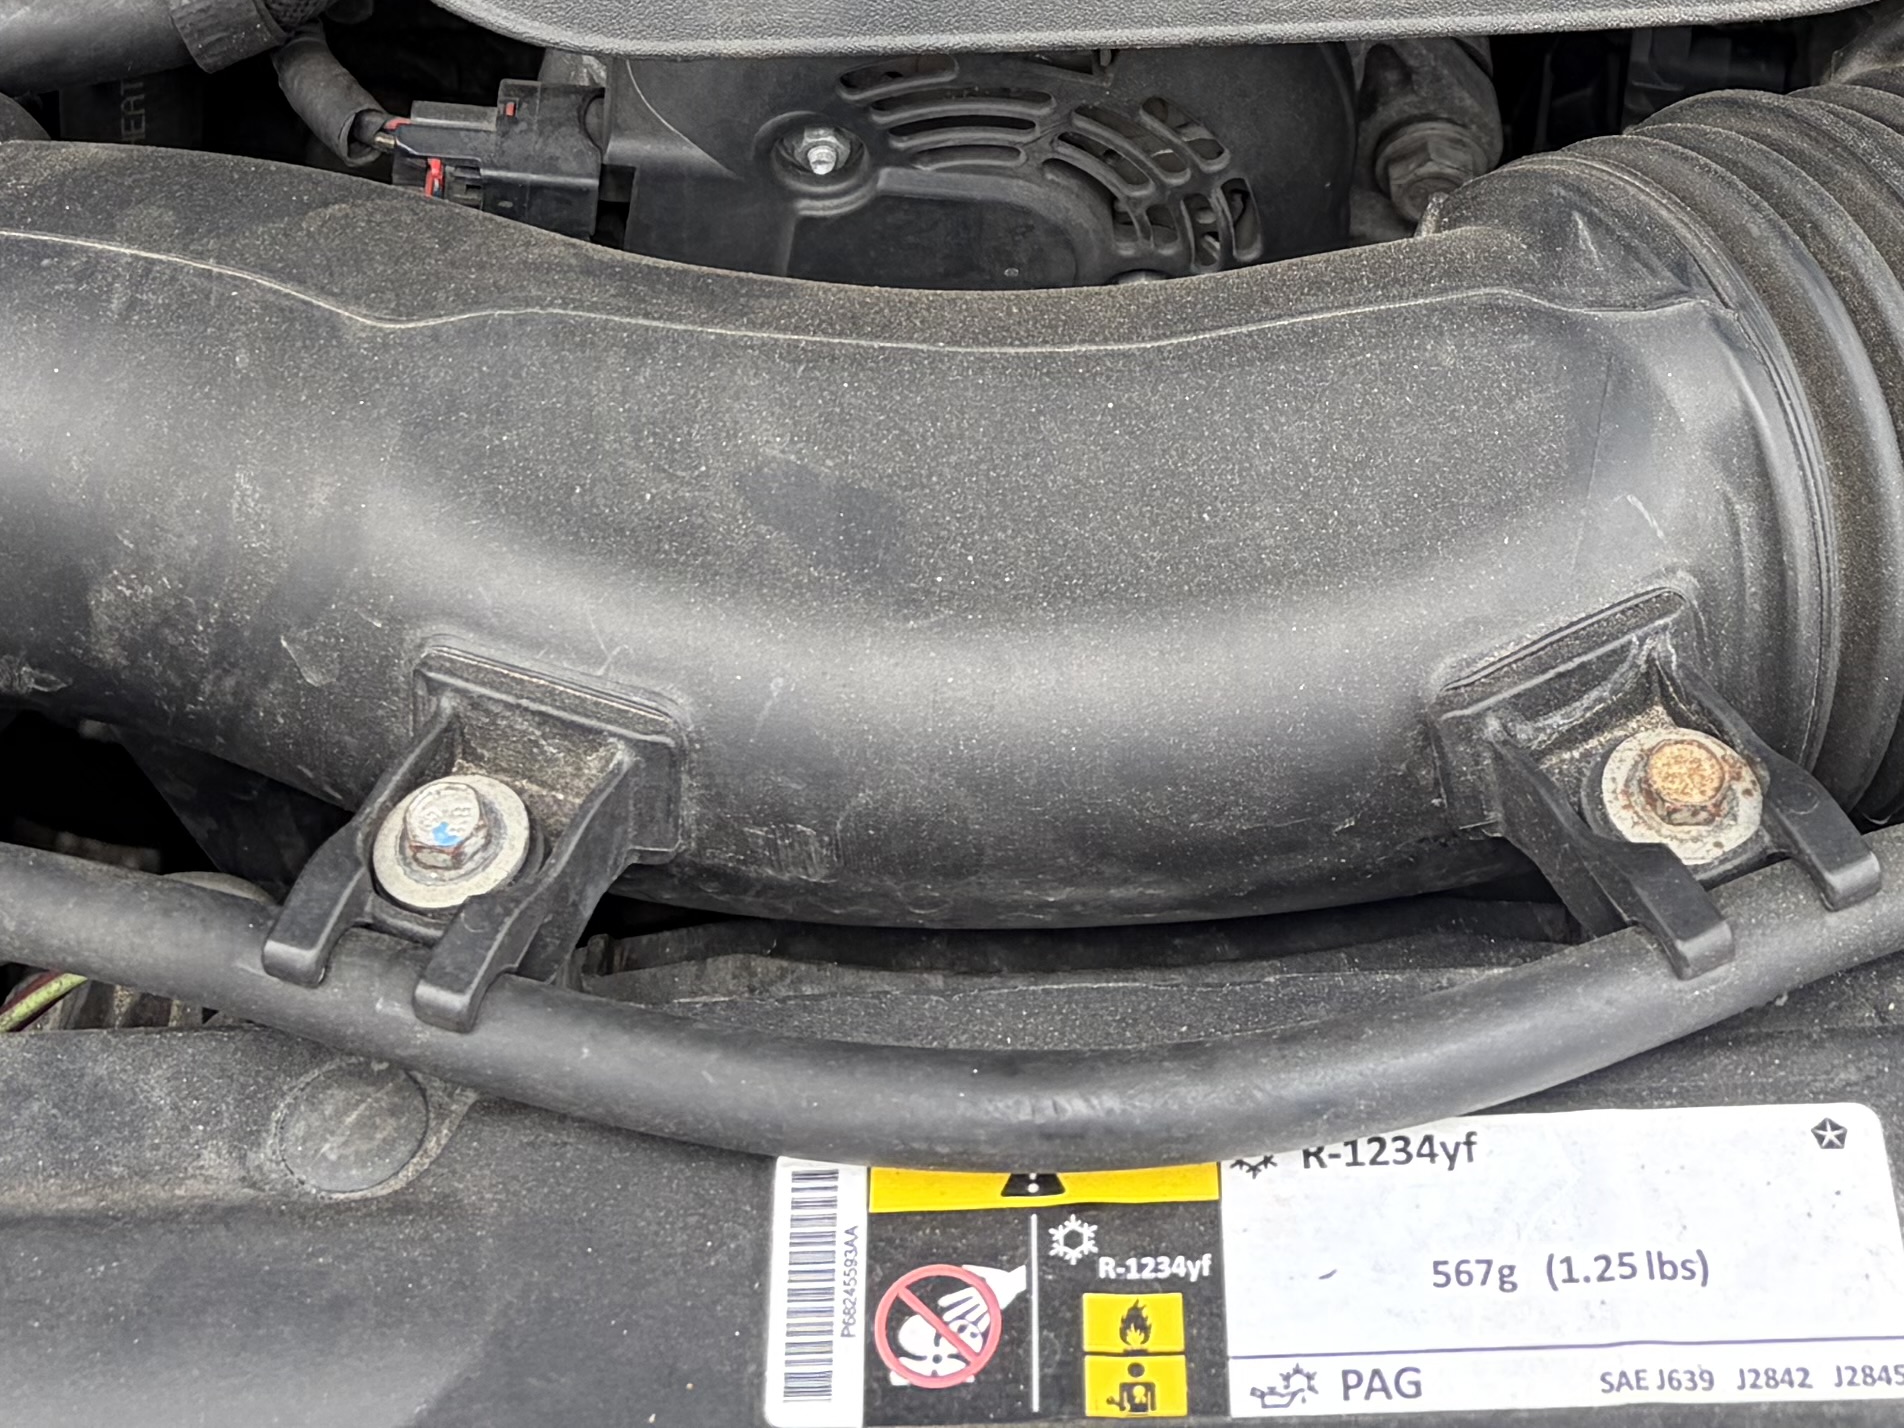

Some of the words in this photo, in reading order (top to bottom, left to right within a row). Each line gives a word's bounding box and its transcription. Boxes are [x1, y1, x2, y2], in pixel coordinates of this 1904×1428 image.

[1302, 1132, 1480, 1169] R-1234yf
[840, 1226, 859, 1338] P68245593AA
[1098, 1253, 1212, 1282] R-1234yf
[1431, 1258, 1519, 1292] 567g
[1545, 1251, 1637, 1290] (1.25
[1646, 1249, 1710, 1287] lbs)
[1341, 1366, 1423, 1401] PAG
[1600, 1370, 1650, 1394] SAE
[1655, 1368, 1714, 1392] J639
[1736, 1366, 1814, 1391] J2842
